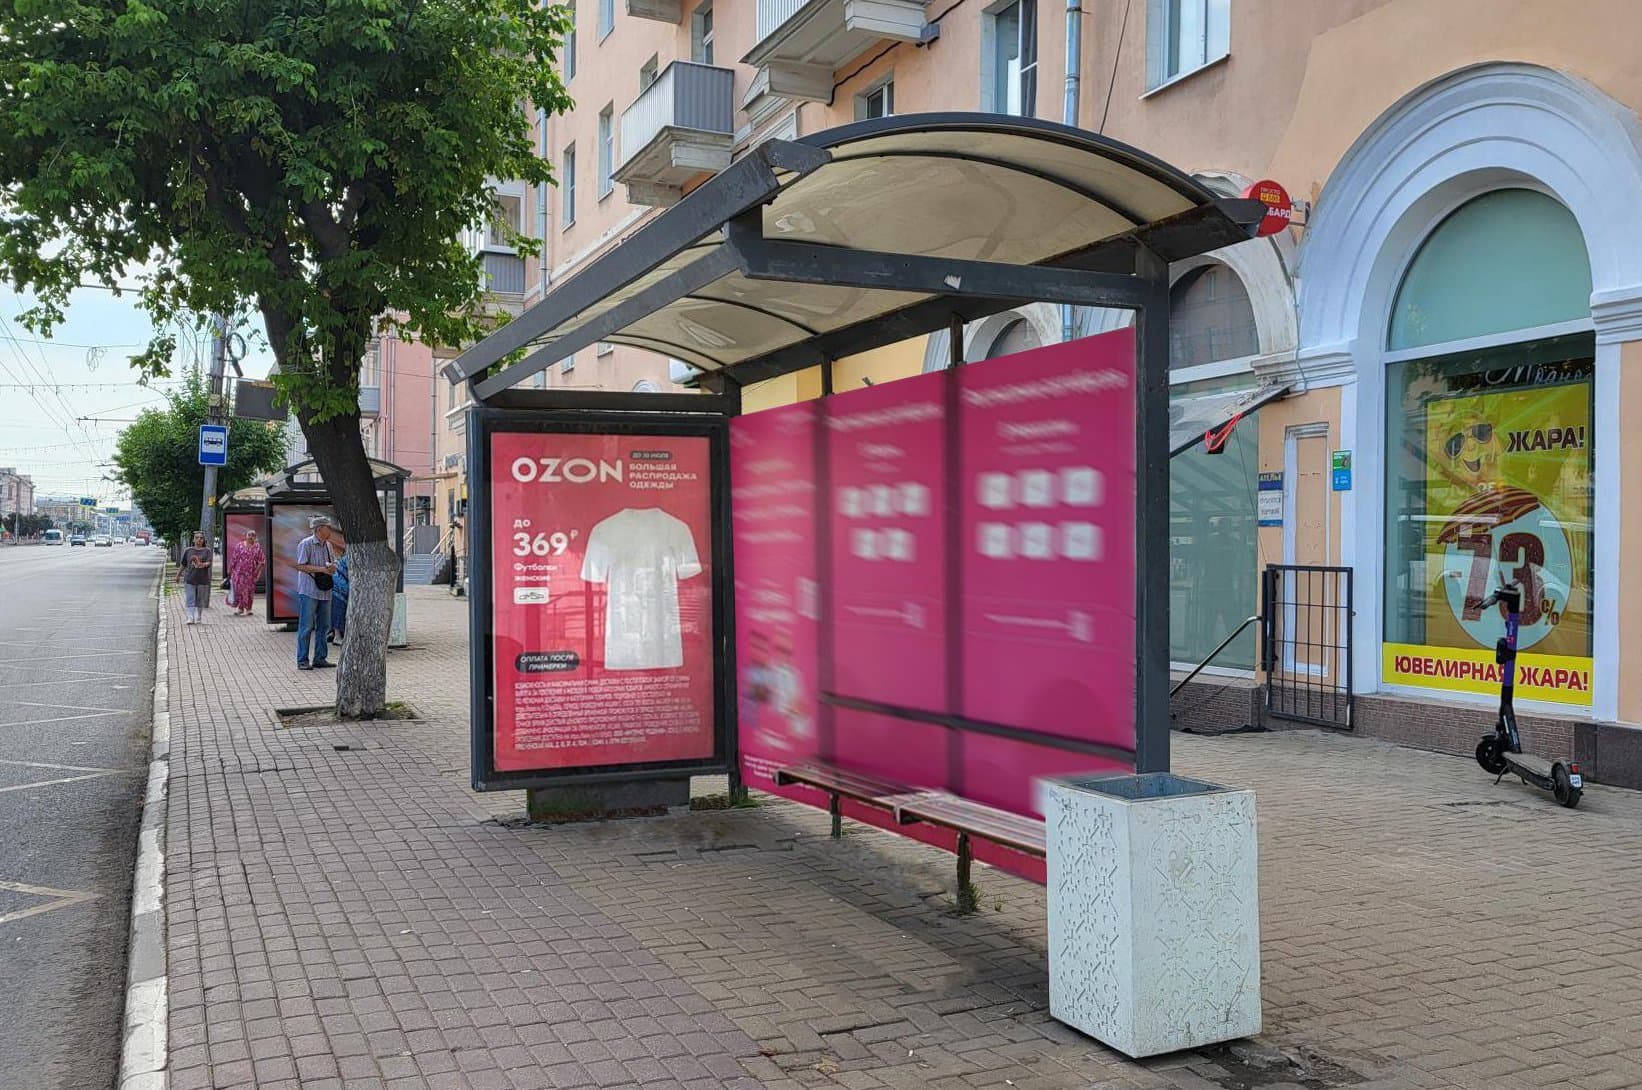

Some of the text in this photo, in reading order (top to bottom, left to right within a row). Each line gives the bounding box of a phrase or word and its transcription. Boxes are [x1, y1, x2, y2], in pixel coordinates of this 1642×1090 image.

[1267, 207, 1291, 219] БАРД
[1507, 426, 1585, 453] ЖАРА!
[511, 457, 623, 484] OZON
[629, 463, 677, 471] БОЛЬШАЯ
[629, 472, 697, 481] РАСПРОДАЖА
[629, 481, 674, 490] ОДЕЖДЫ
[513, 562, 558, 573] Футболки
[519, 653, 574, 664] ОПЛАТА ПОСЛЕ
[528, 662, 568, 671] ПРИМЕРКИ
[1520, 666, 1589, 691] ЖАРА!
